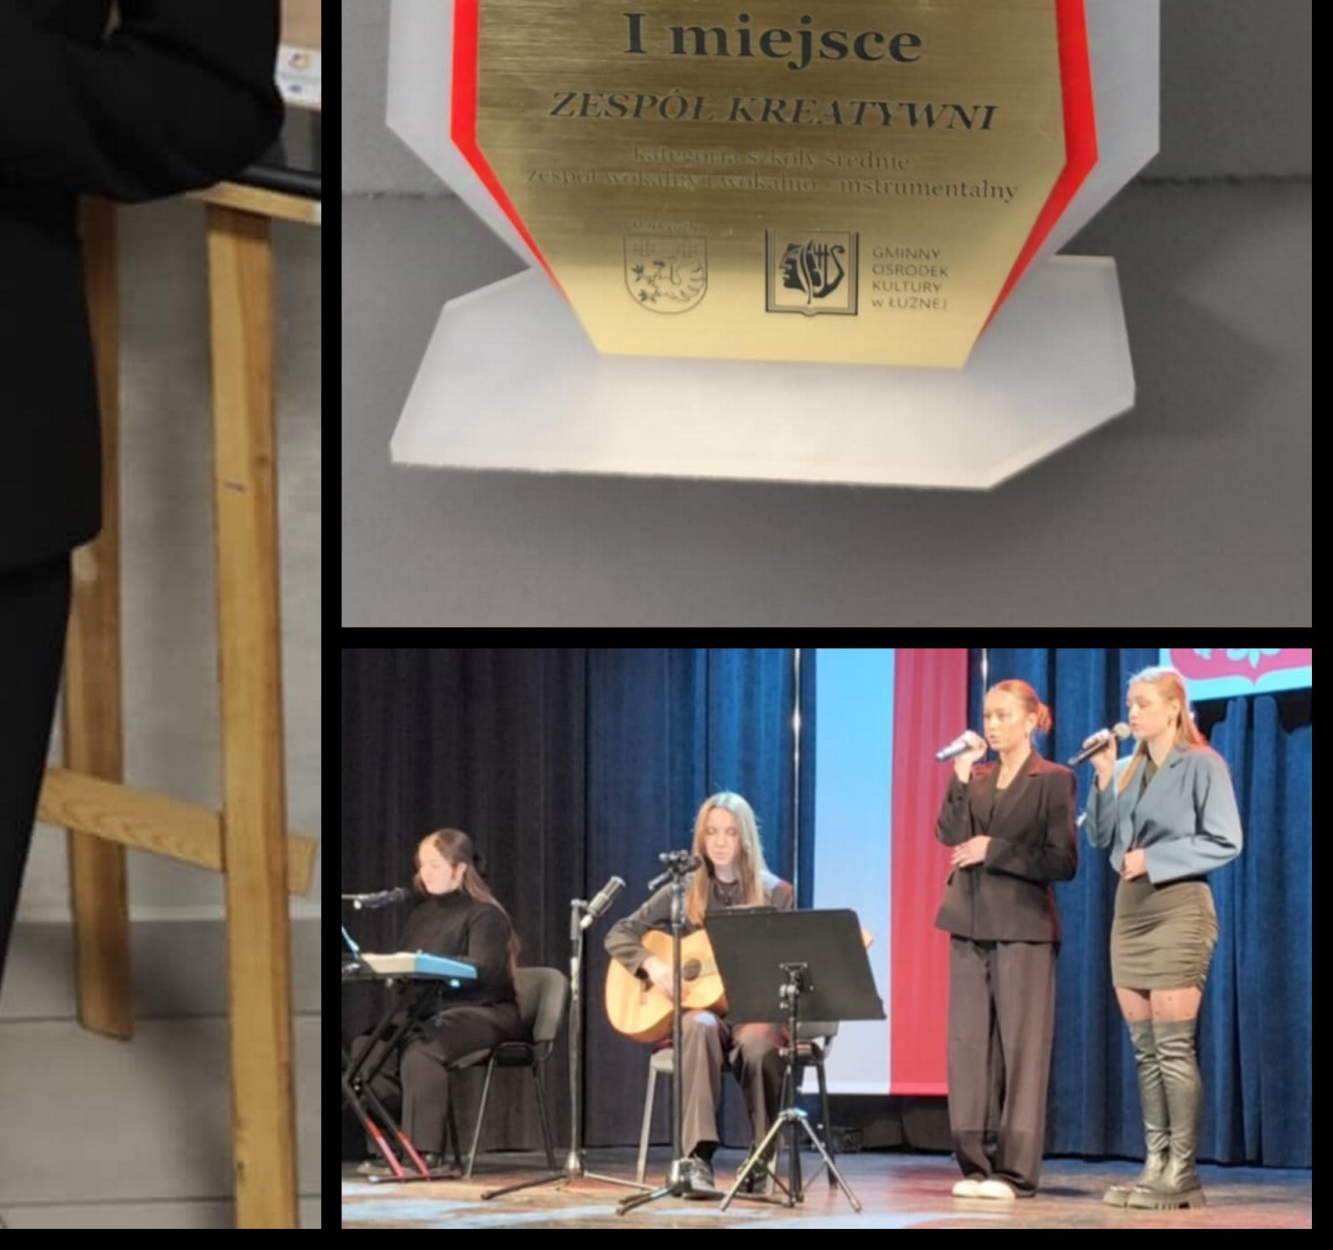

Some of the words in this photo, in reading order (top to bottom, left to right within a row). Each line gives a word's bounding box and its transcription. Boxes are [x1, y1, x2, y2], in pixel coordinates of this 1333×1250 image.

[623, 13, 646, 54] I
[670, 13, 922, 70] miejsce
[549, 88, 716, 121] ZESPÓŁ
[728, 97, 998, 131] KREATYWNI
[840, 177, 1019, 204] instrumentalny
[872, 246, 941, 260] GMINNY
[871, 280, 942, 294] KULTURY
